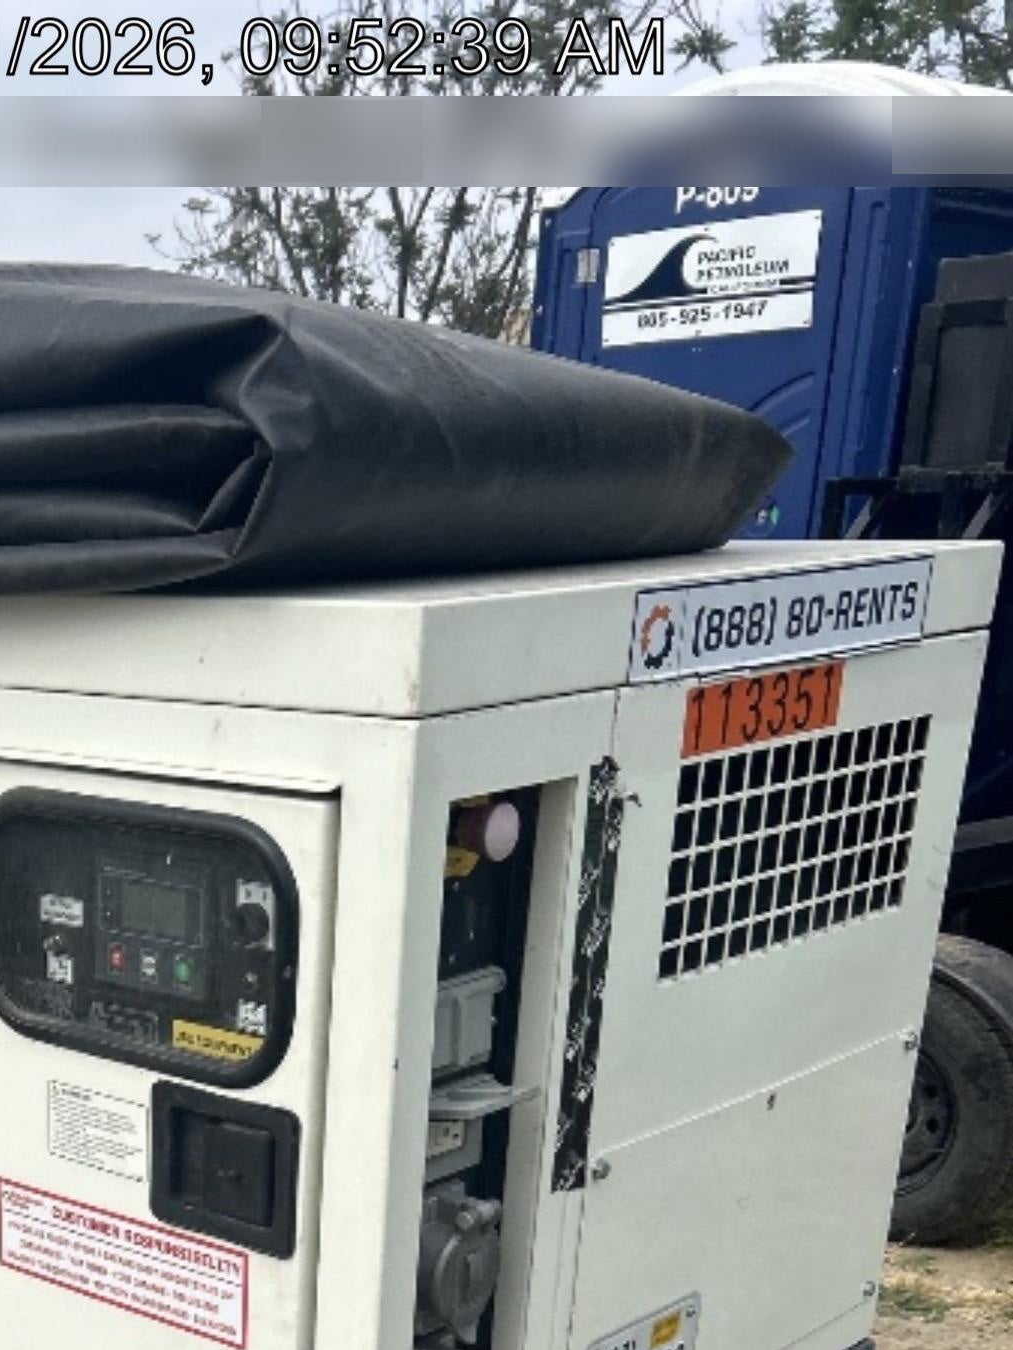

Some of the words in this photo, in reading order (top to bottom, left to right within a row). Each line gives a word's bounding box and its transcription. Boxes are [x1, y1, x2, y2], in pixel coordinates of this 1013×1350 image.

[696, 245, 757, 266] PACIFIC
[696, 257, 790, 281] PETROLEUM
[637, 300, 768, 329] 805-925-1947
[691, 596, 778, 657] (888)
[784, 581, 919, 640] 80-RENTS
[691, 664, 835, 751] 113351
[51, 1204, 120, 1241] CUSTOMER
